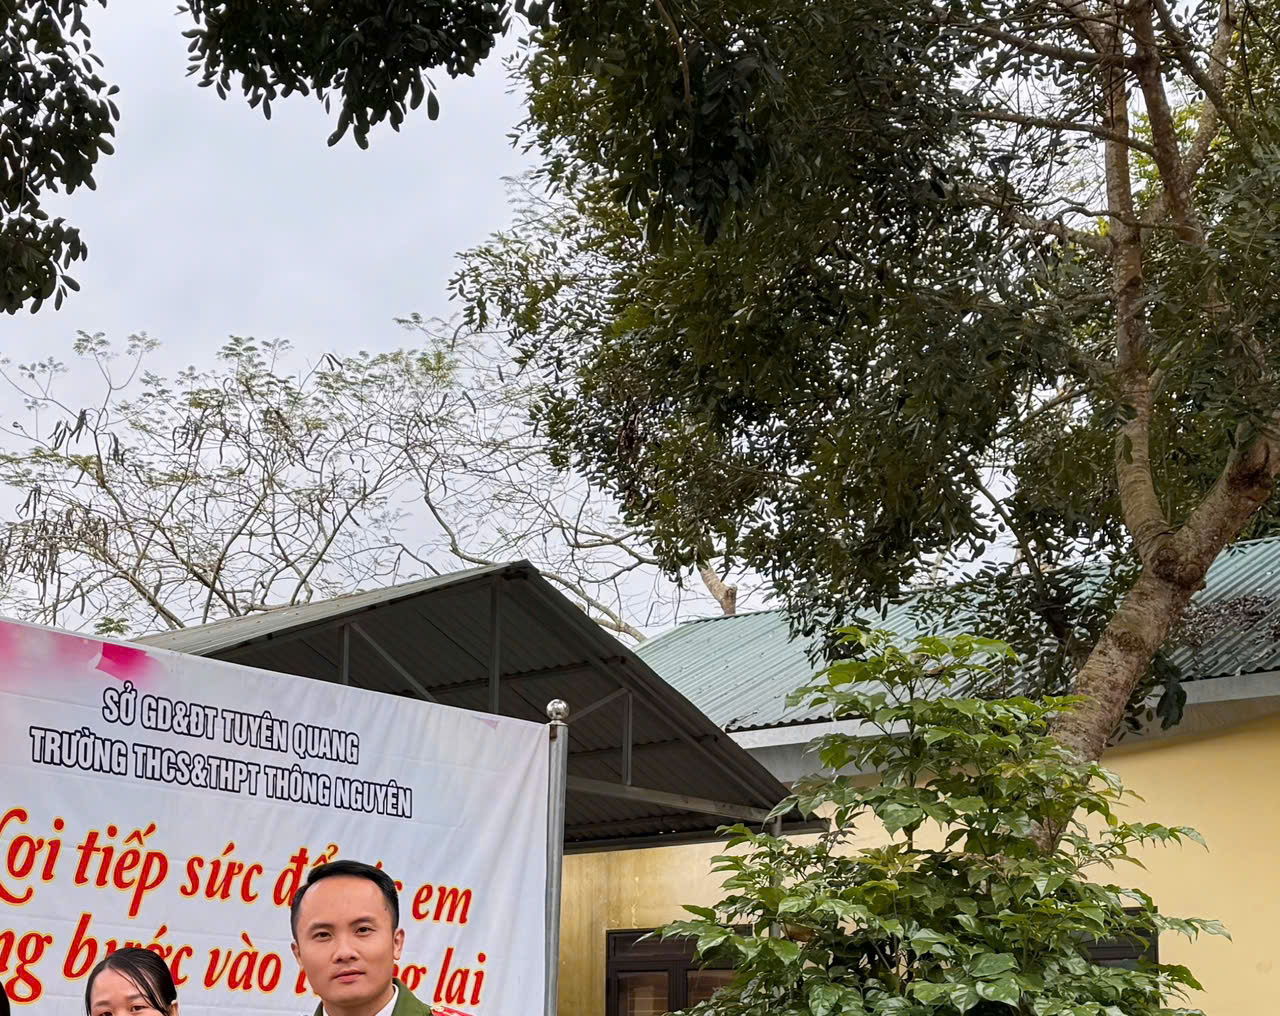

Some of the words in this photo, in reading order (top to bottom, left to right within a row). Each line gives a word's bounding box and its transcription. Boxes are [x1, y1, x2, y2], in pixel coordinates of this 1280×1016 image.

[102, 680, 138, 726] SỞ
[140, 695, 219, 740] GD&ĐT
[221, 709, 290, 754] TUYÊN
[292, 722, 360, 765] QUANG
[29, 726, 127, 775] TRƯỜNG
[132, 742, 261, 796] THCS&THPT
[263, 760, 332, 807] THÔNG
[334, 776, 413, 819] NGUYÊN
[74, 822, 169, 918] tiếp
[179, 841, 264, 903] sức
[411, 883, 473, 925] em
[203, 931, 283, 992] vào
[432, 946, 487, 1006] lai
